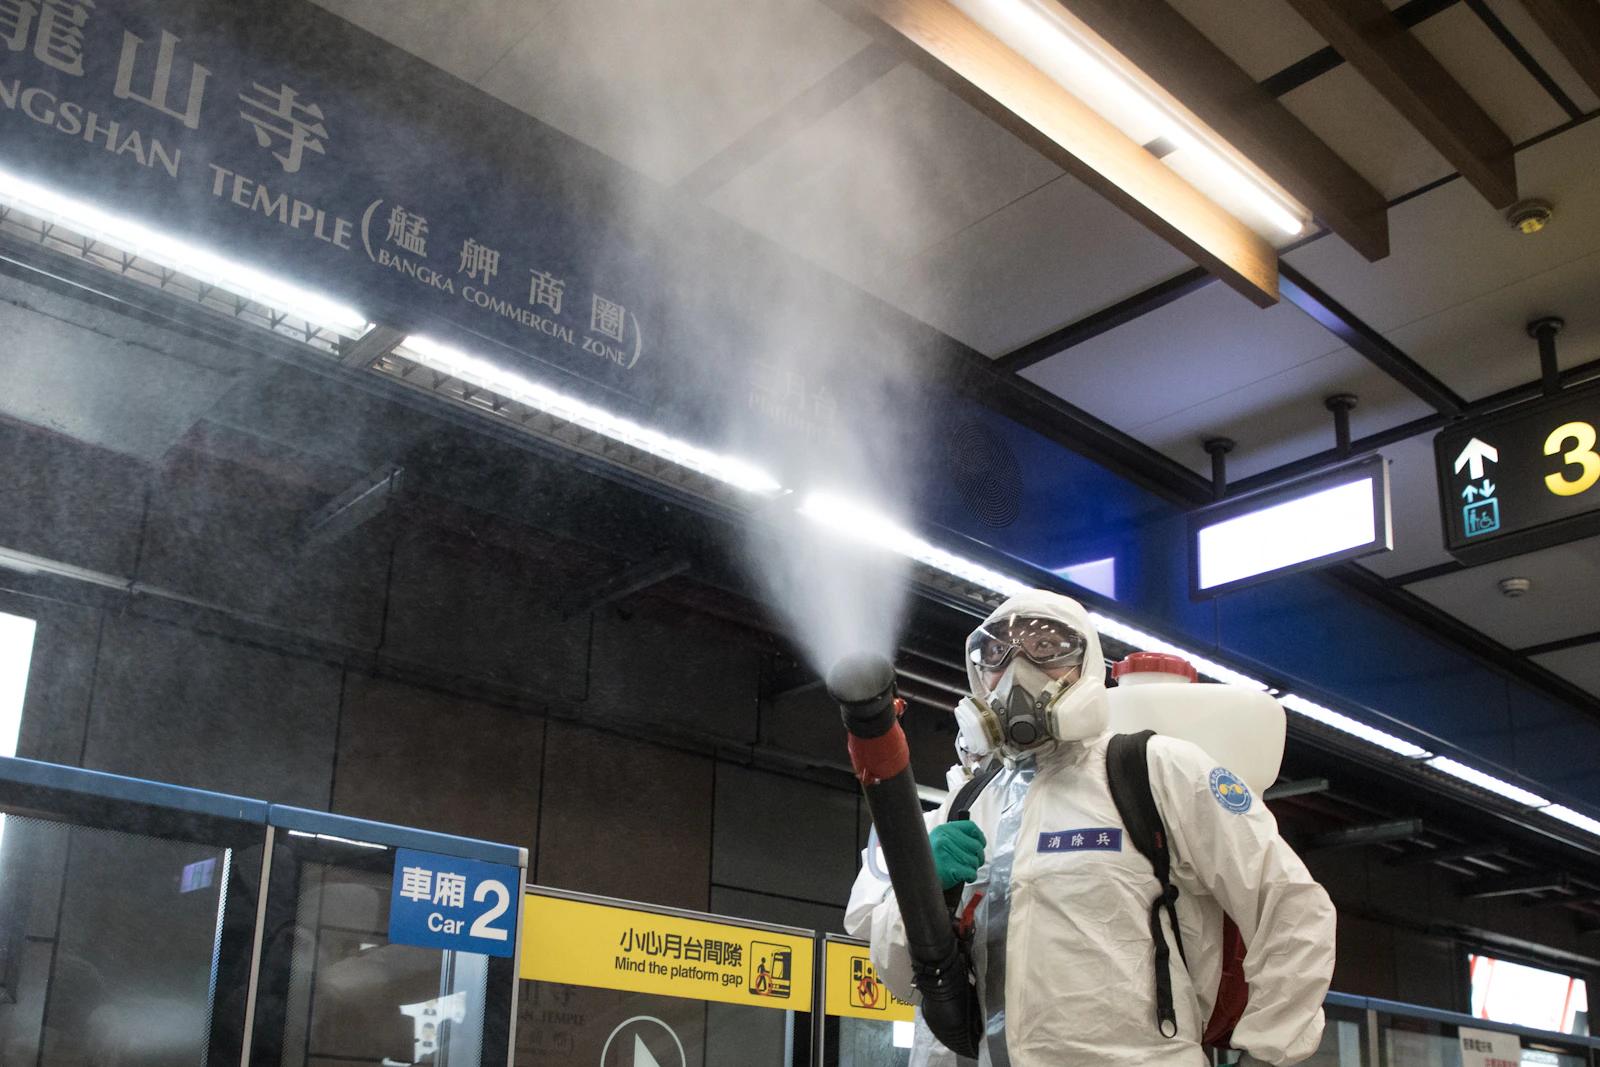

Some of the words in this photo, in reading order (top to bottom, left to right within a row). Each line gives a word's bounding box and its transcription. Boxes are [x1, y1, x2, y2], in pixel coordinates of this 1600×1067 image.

[208, 163, 353, 250] TEMPLE
[378, 249, 455, 295] BANGKA
[462, 286, 577, 345] COMMERCIAL
[582, 336, 626, 367] ZONE
[1544, 421, 1600, 496] 3
[1048, 832, 1111, 848] 消除兵
[400, 867, 466, 908] 車廂
[469, 879, 510, 941] 2
[427, 912, 465, 935] Car
[619, 927, 743, 968] 小心月台間隙
[615, 956, 645, 973] Mind
[649, 961, 668, 976] the
[670, 964, 719, 982] platform
[722, 971, 743, 988] gap
